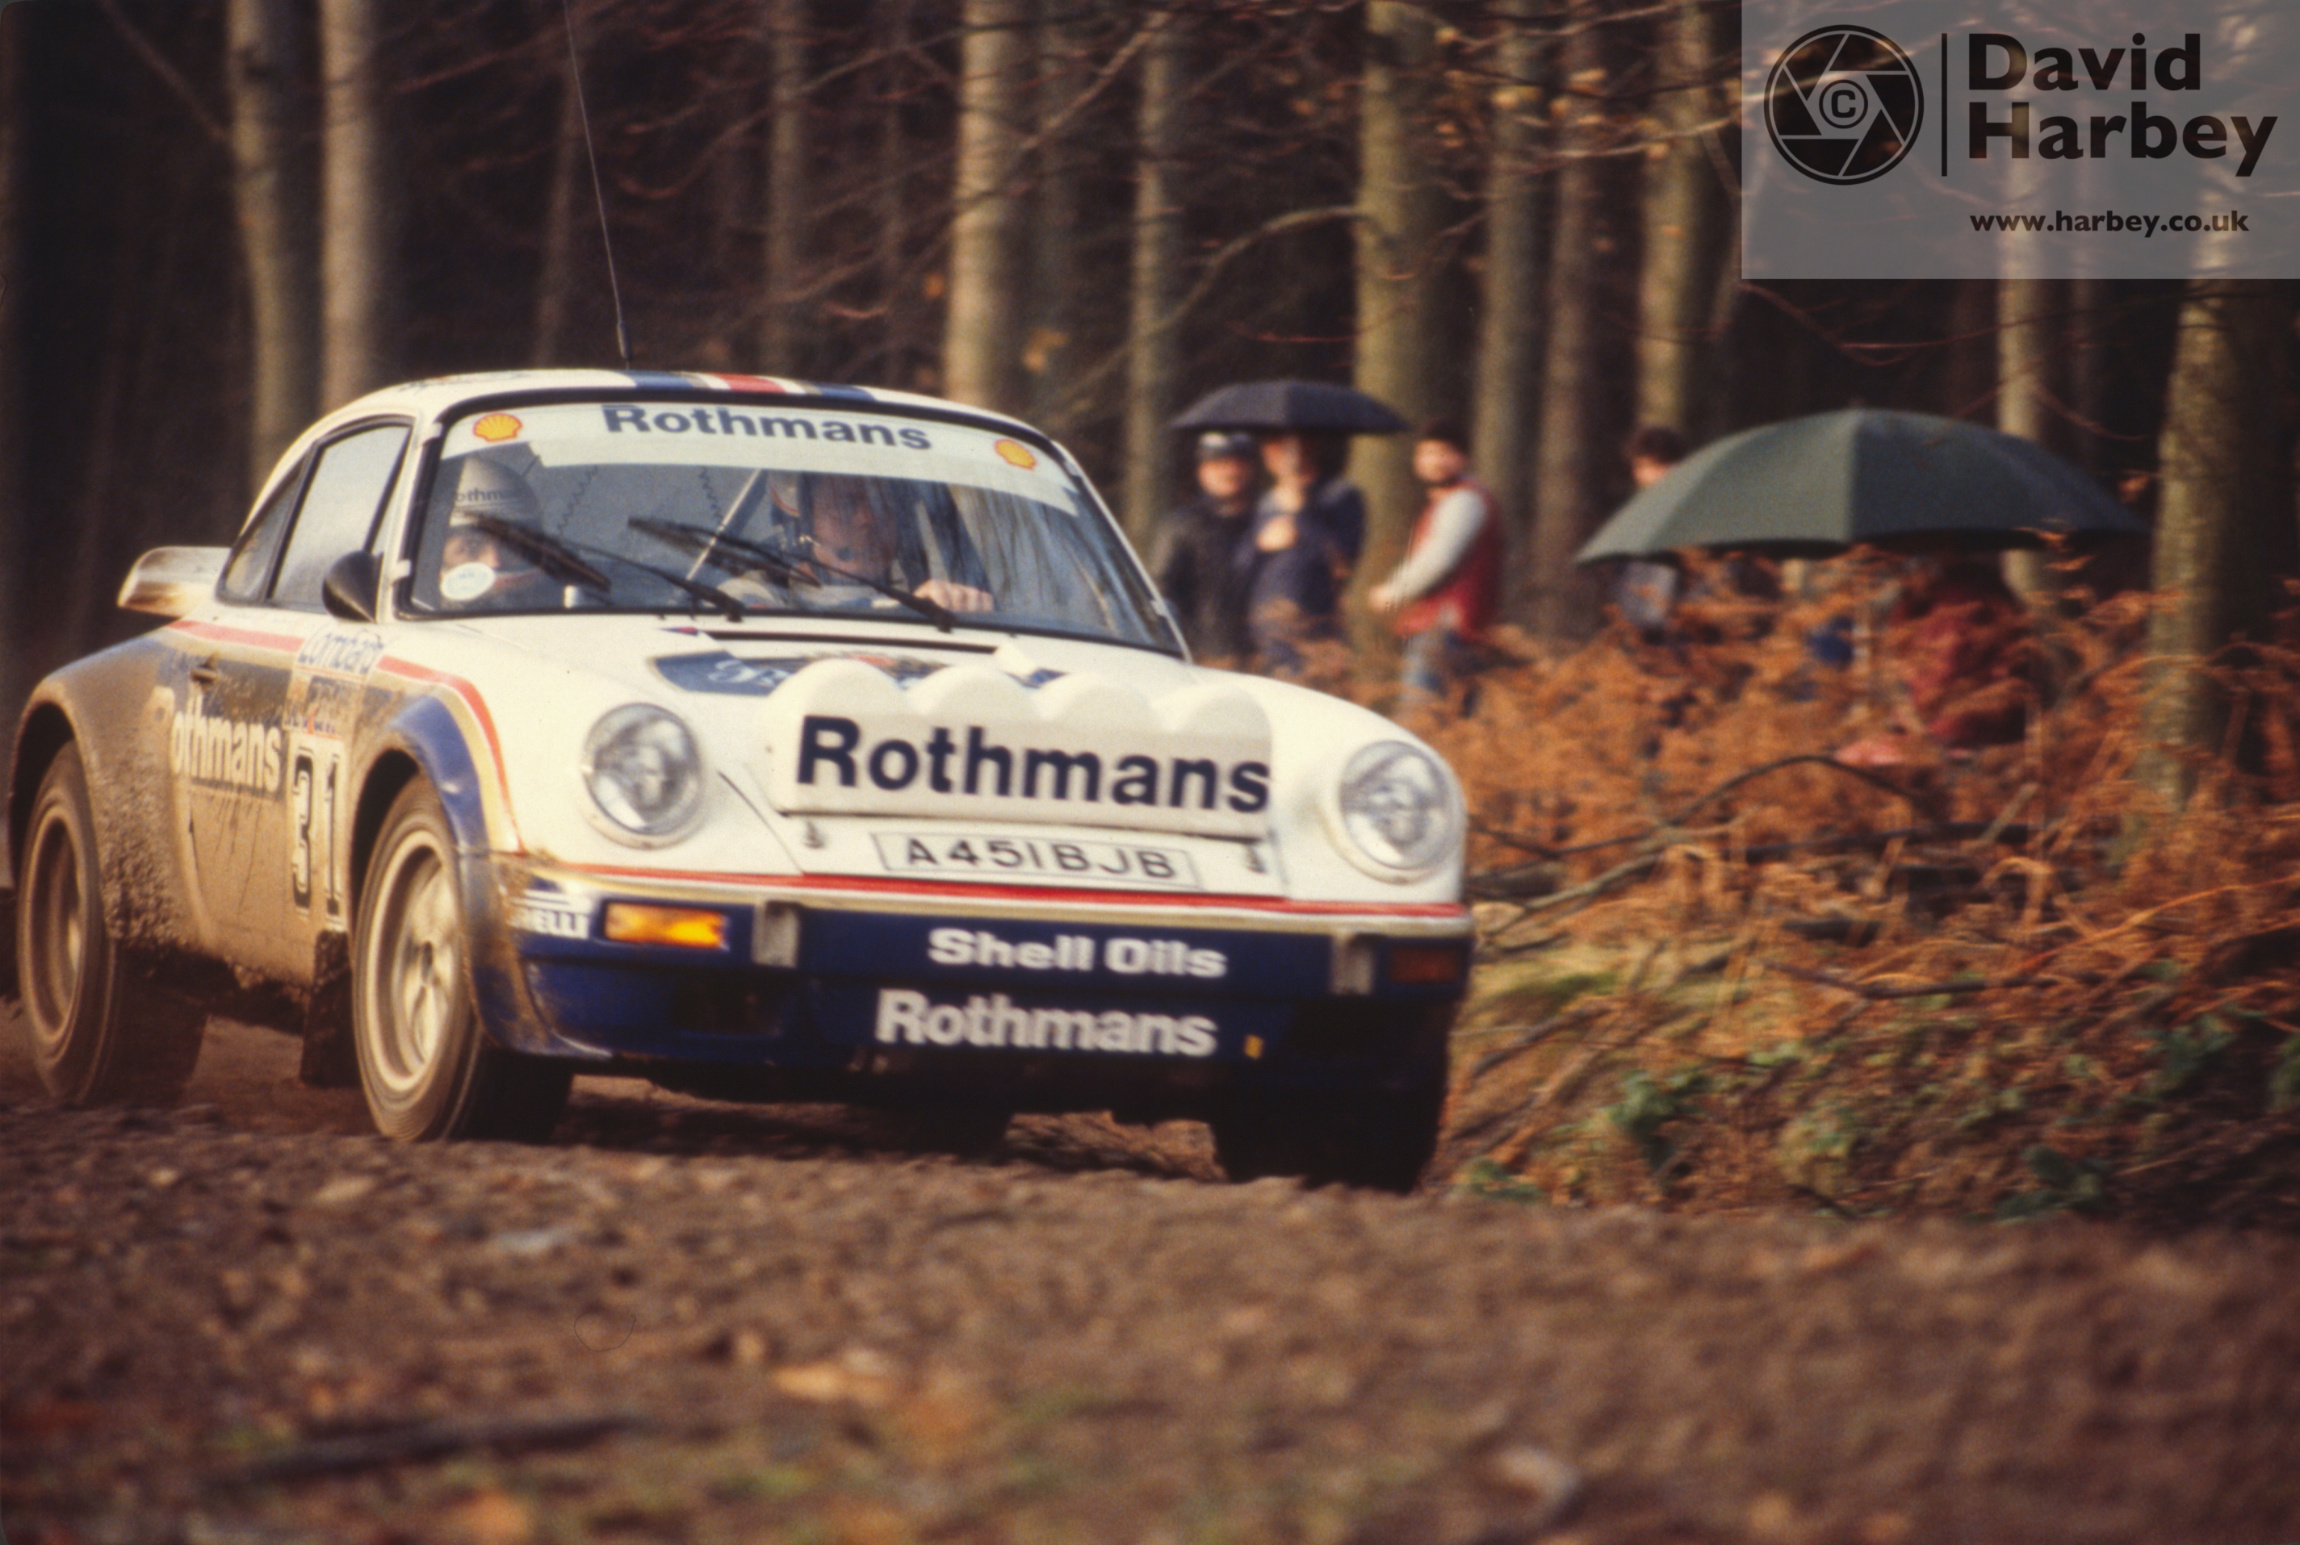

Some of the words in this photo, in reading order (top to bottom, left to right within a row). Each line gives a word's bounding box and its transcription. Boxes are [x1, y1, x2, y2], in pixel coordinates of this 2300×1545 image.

[602, 404, 932, 450] Rothmans
[797, 714, 1270, 813] Rothmans
[289, 747, 343, 922] 31
[928, 927, 1096, 971] Shell
[1104, 937, 1228, 978] Oils
[874, 988, 1218, 1057] Rothmans
